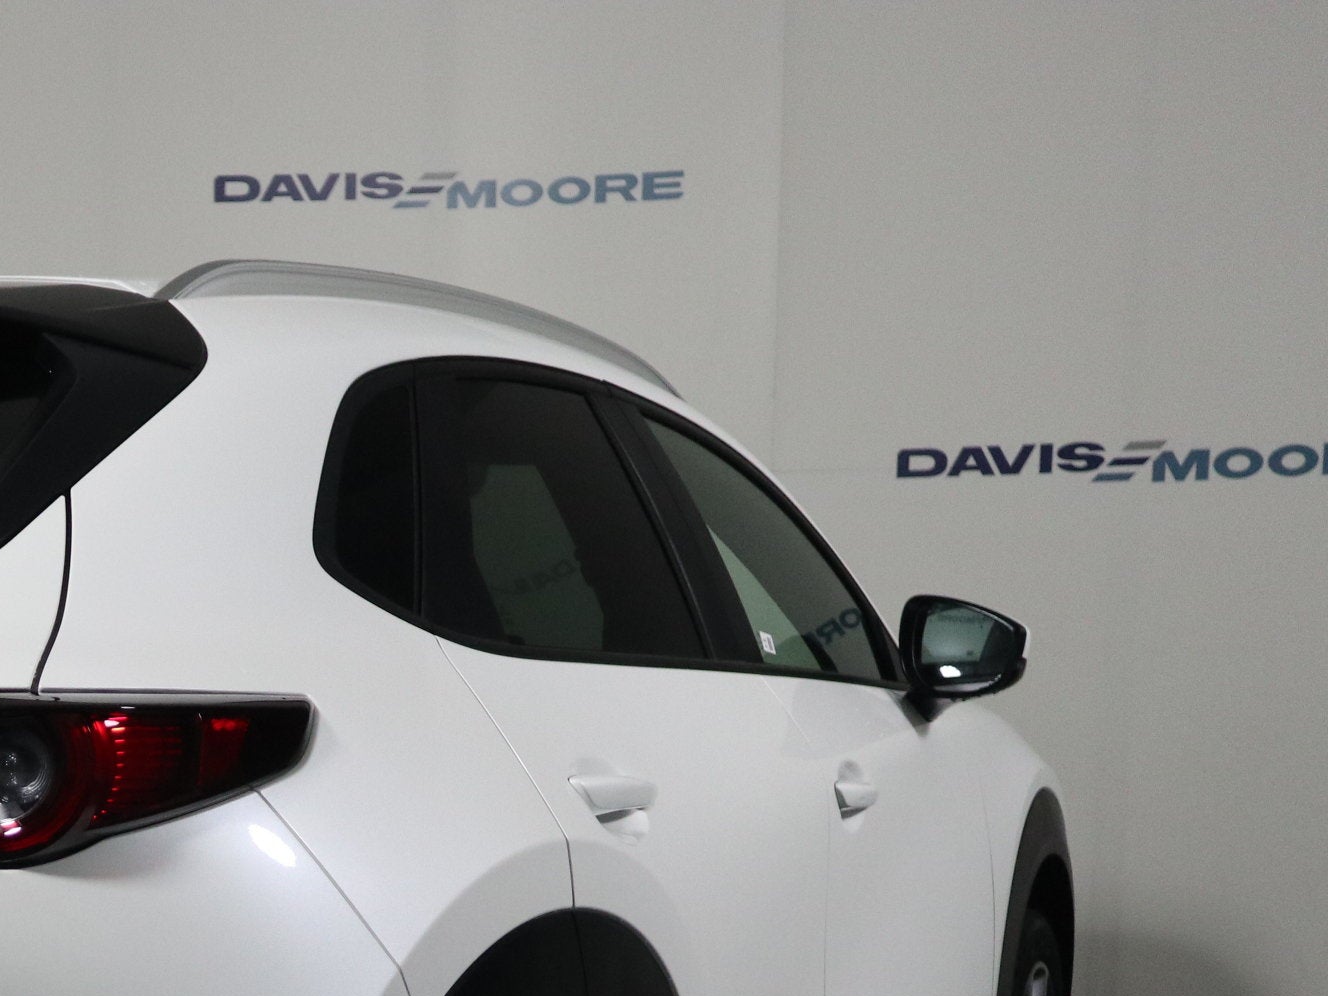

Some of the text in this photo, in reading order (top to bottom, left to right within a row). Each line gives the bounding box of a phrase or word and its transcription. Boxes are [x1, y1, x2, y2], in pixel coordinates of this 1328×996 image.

[213, 170, 685, 209] DAVIS MOORE
[896, 441, 1328, 483] DAVIS MOO
